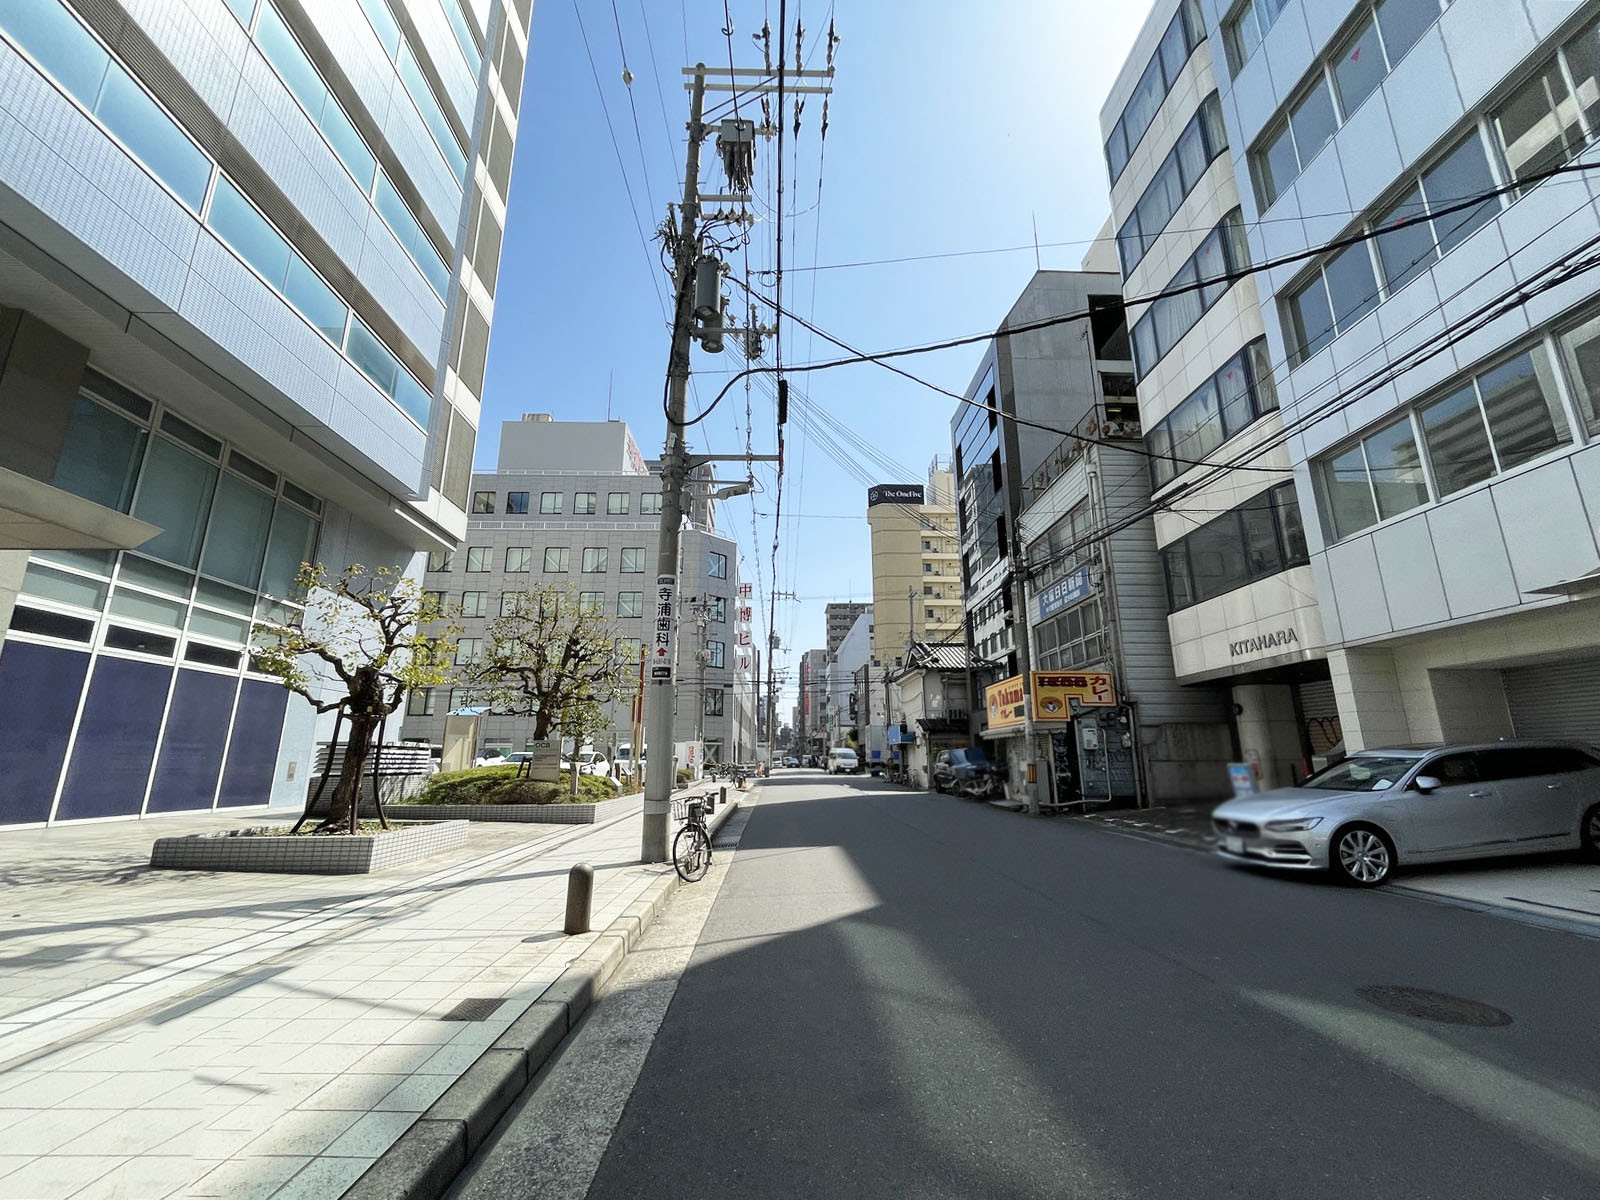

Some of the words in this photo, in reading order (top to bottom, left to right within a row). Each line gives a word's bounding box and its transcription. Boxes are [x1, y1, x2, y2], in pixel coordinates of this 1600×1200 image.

[656, 587, 672, 647] 寺浦歯科
[1229, 627, 1298, 657] KITAHARA
[1090, 676, 1109, 702] カレー
